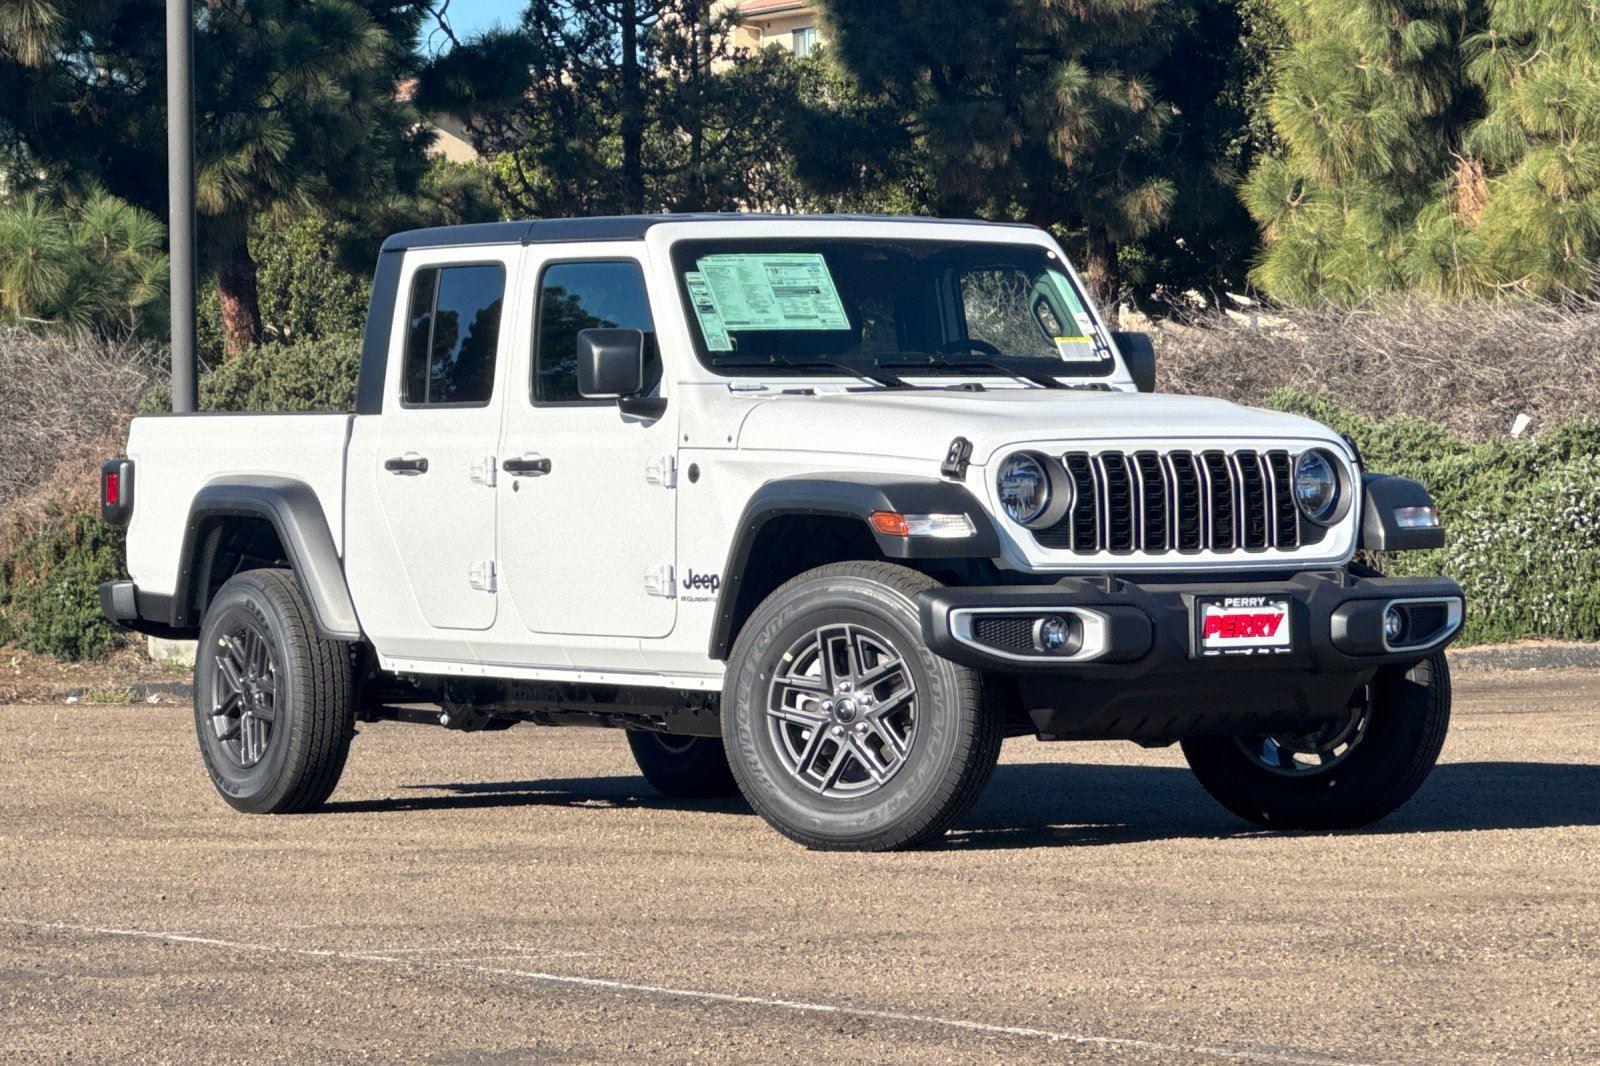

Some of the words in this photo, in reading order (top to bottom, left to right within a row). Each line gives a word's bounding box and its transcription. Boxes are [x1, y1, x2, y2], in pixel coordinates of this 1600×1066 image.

[683, 568, 719, 593] Jeep
[1225, 597, 1265, 607] PERRY
[1202, 613, 1284, 639] PERRY
